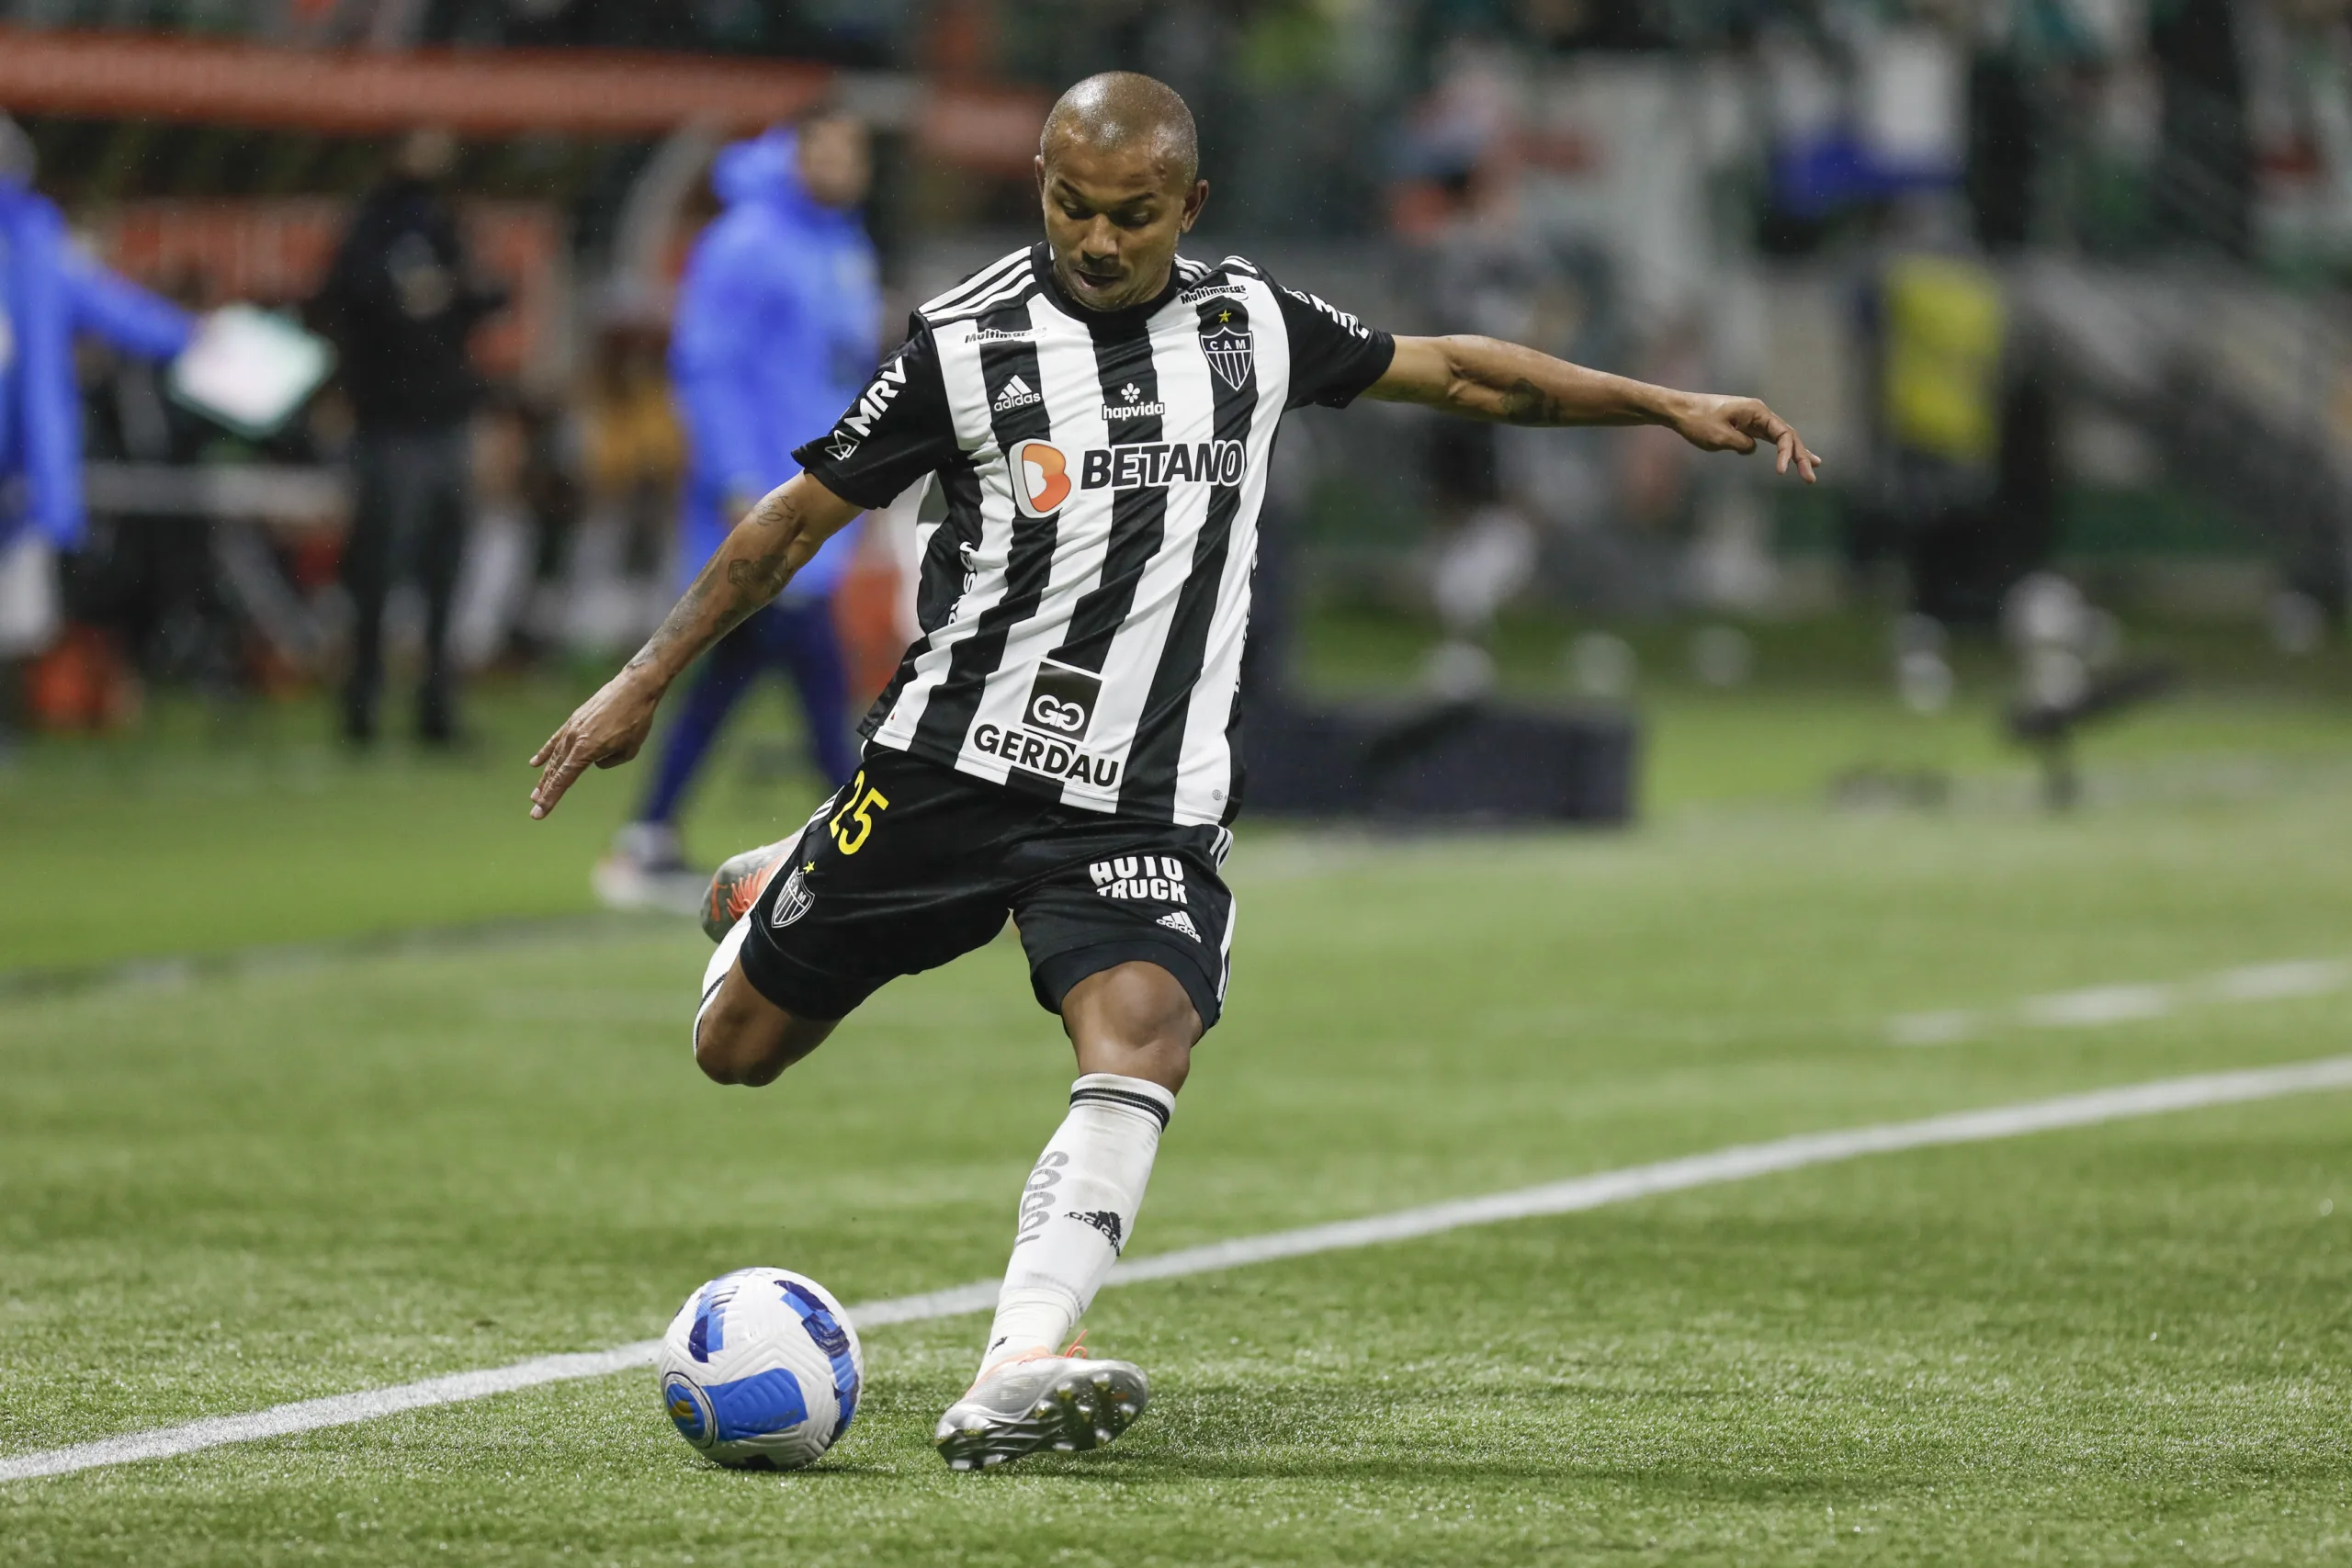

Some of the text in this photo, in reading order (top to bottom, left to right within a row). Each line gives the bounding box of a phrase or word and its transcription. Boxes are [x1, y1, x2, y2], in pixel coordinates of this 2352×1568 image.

[1181, 284, 1247, 305] Multimarcas
[1209, 339, 1247, 351] CAM
[843, 355, 907, 437] MRV
[993, 393, 1042, 412] adidas
[1103, 402, 1165, 421] hapvida
[1080, 443, 1245, 491] BETANO
[974, 724, 1119, 787] GERDAU
[829, 770, 889, 855] 25
[1096, 878, 1188, 905] TRUCK
[1156, 919, 1202, 943] adidas
